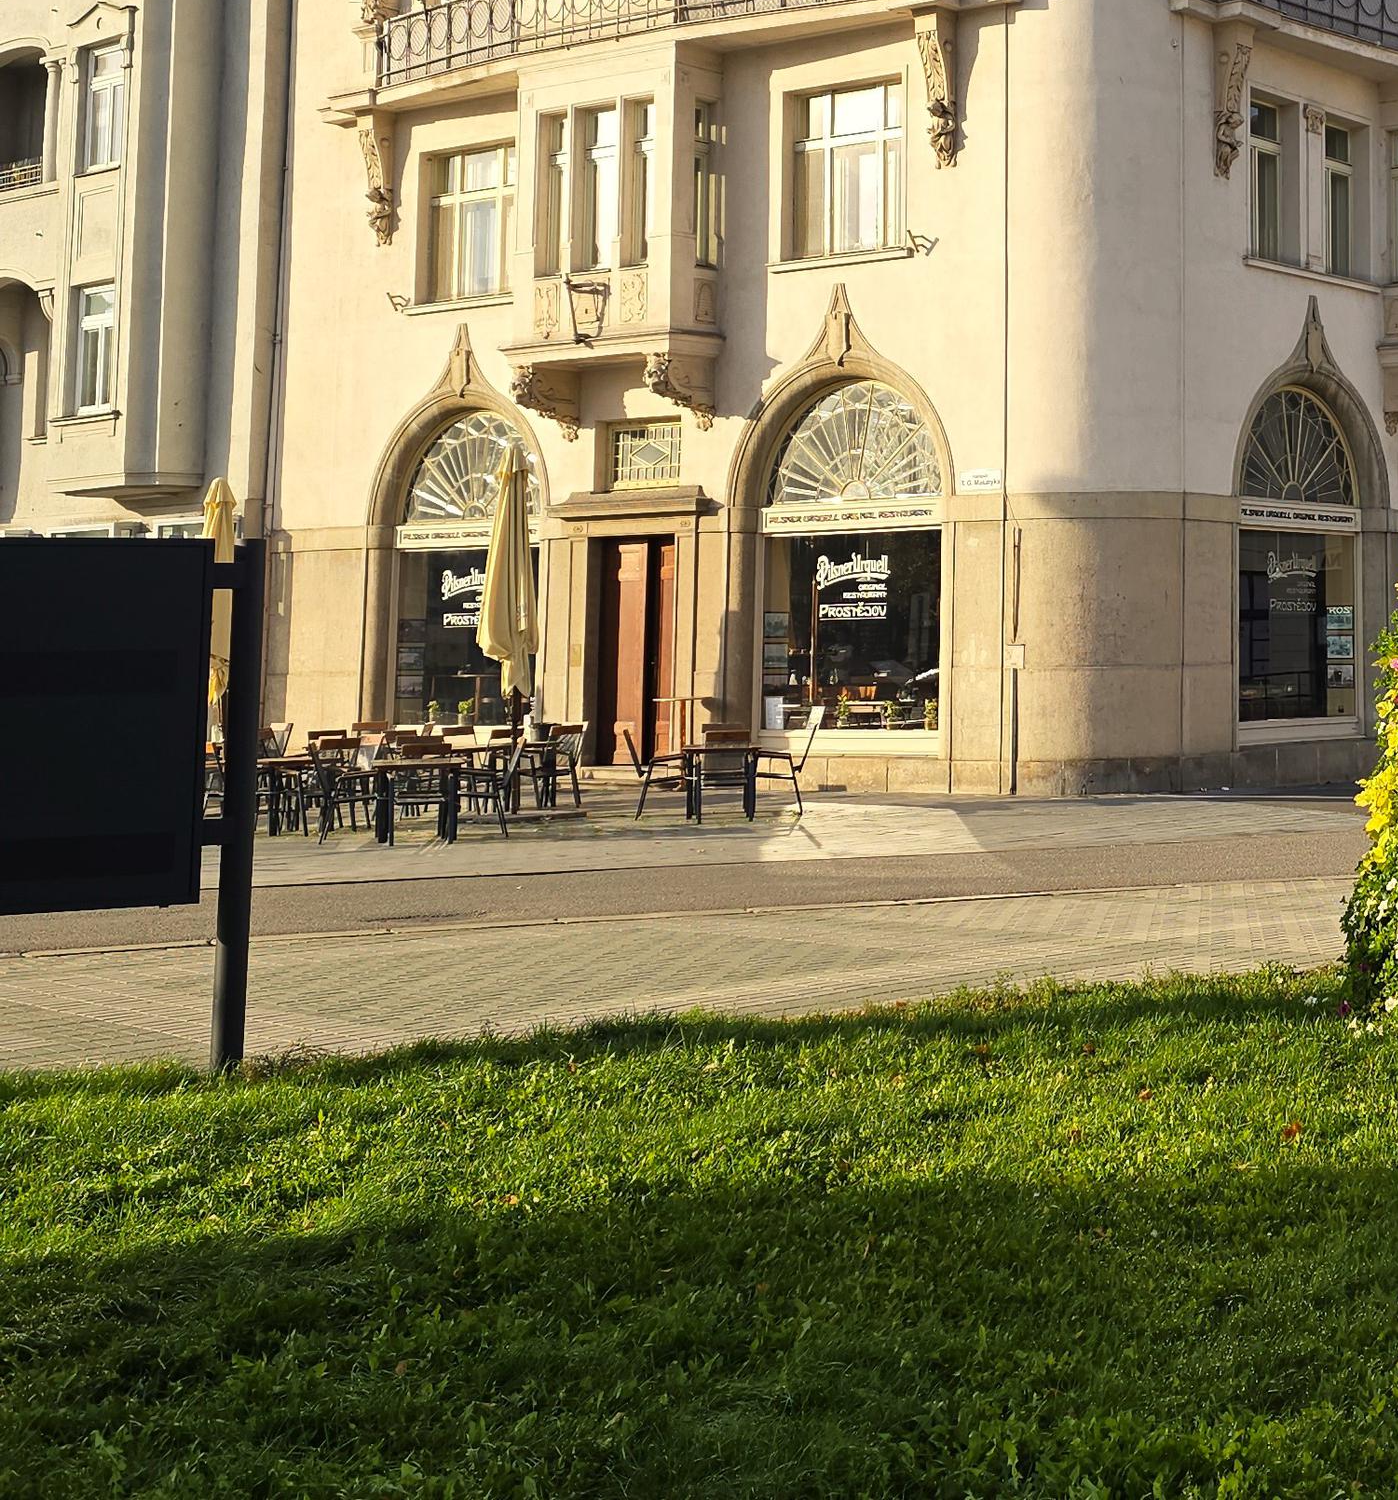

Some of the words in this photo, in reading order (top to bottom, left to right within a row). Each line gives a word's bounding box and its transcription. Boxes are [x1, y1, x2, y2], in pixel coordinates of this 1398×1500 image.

[441, 569, 473, 600] Pilsner
[816, 554, 855, 590] Pilsner
[851, 552, 891, 580] Urquell
[819, 602, 887, 618] PROSTĚJOV
